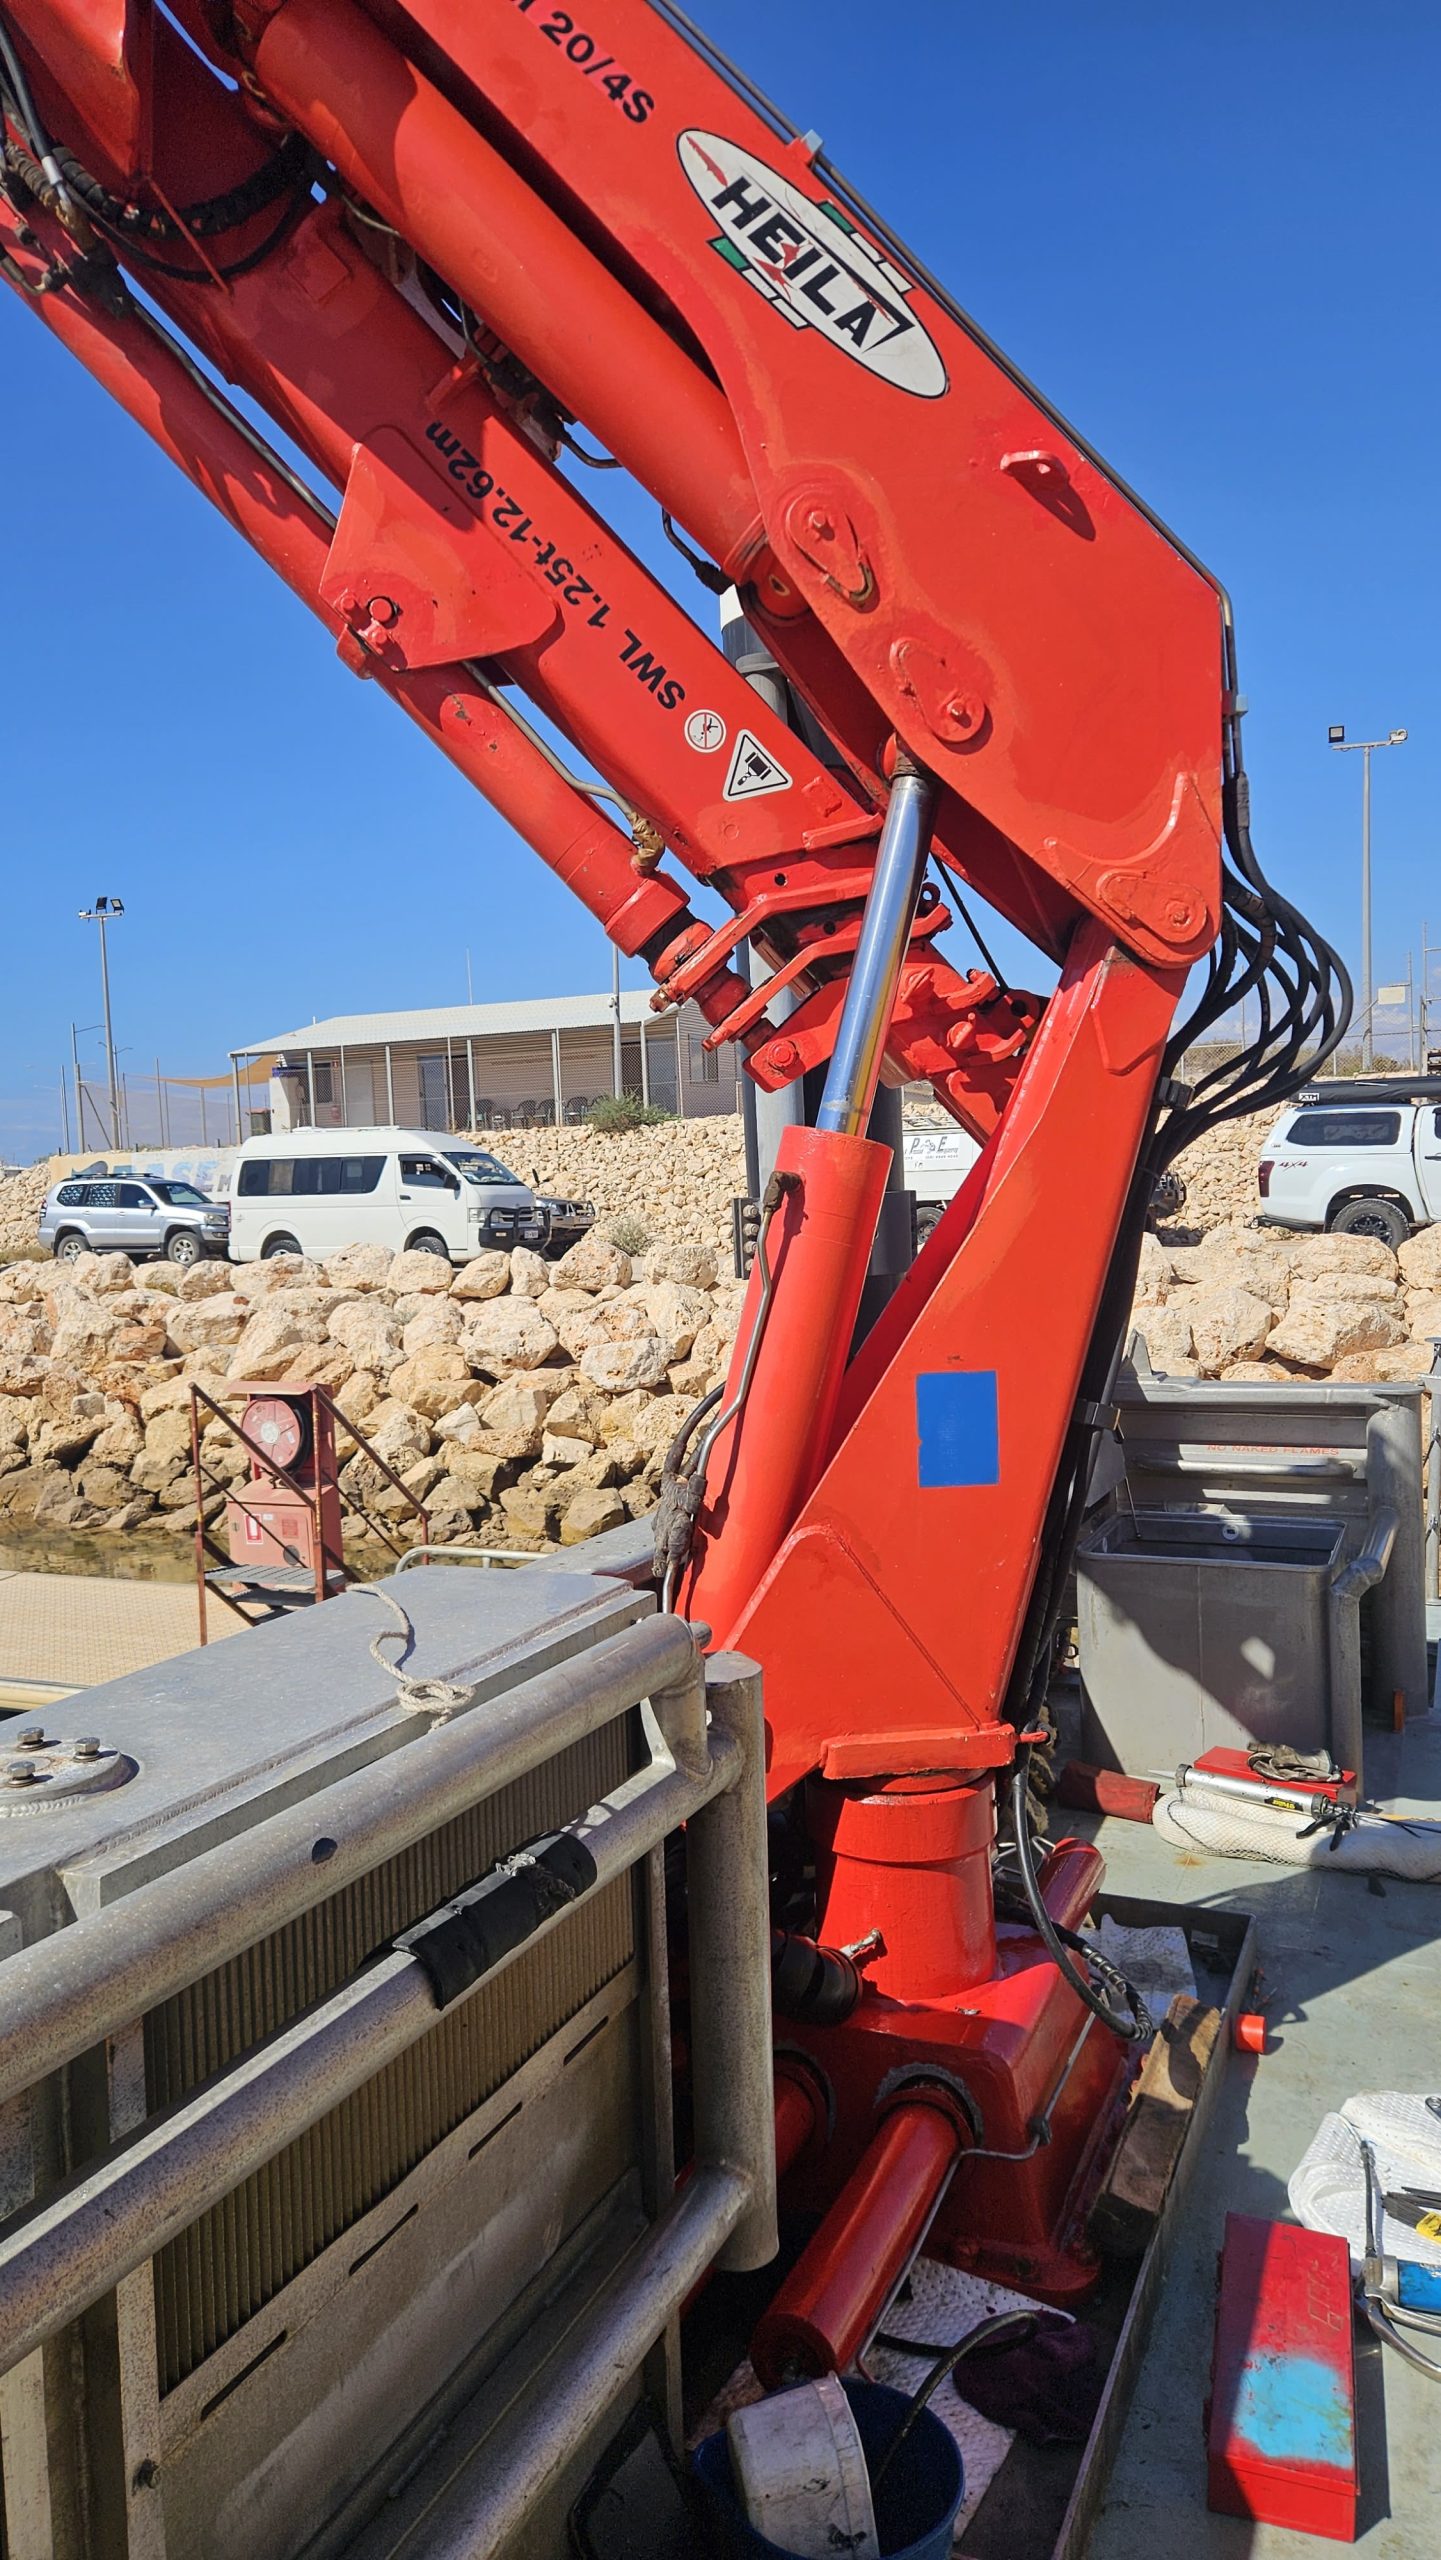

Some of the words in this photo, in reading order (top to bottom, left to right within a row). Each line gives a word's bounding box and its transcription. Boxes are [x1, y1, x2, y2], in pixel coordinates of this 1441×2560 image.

[539, 11, 655, 123] 20/4S
[711, 175, 916, 353] HEILA
[426, 419, 612, 630] 1.25t-12.62m
[618, 628, 686, 711] SWL
[1231, 1446, 1279, 1454] NAKED
[1283, 1448, 1340, 1456] FLAMES
